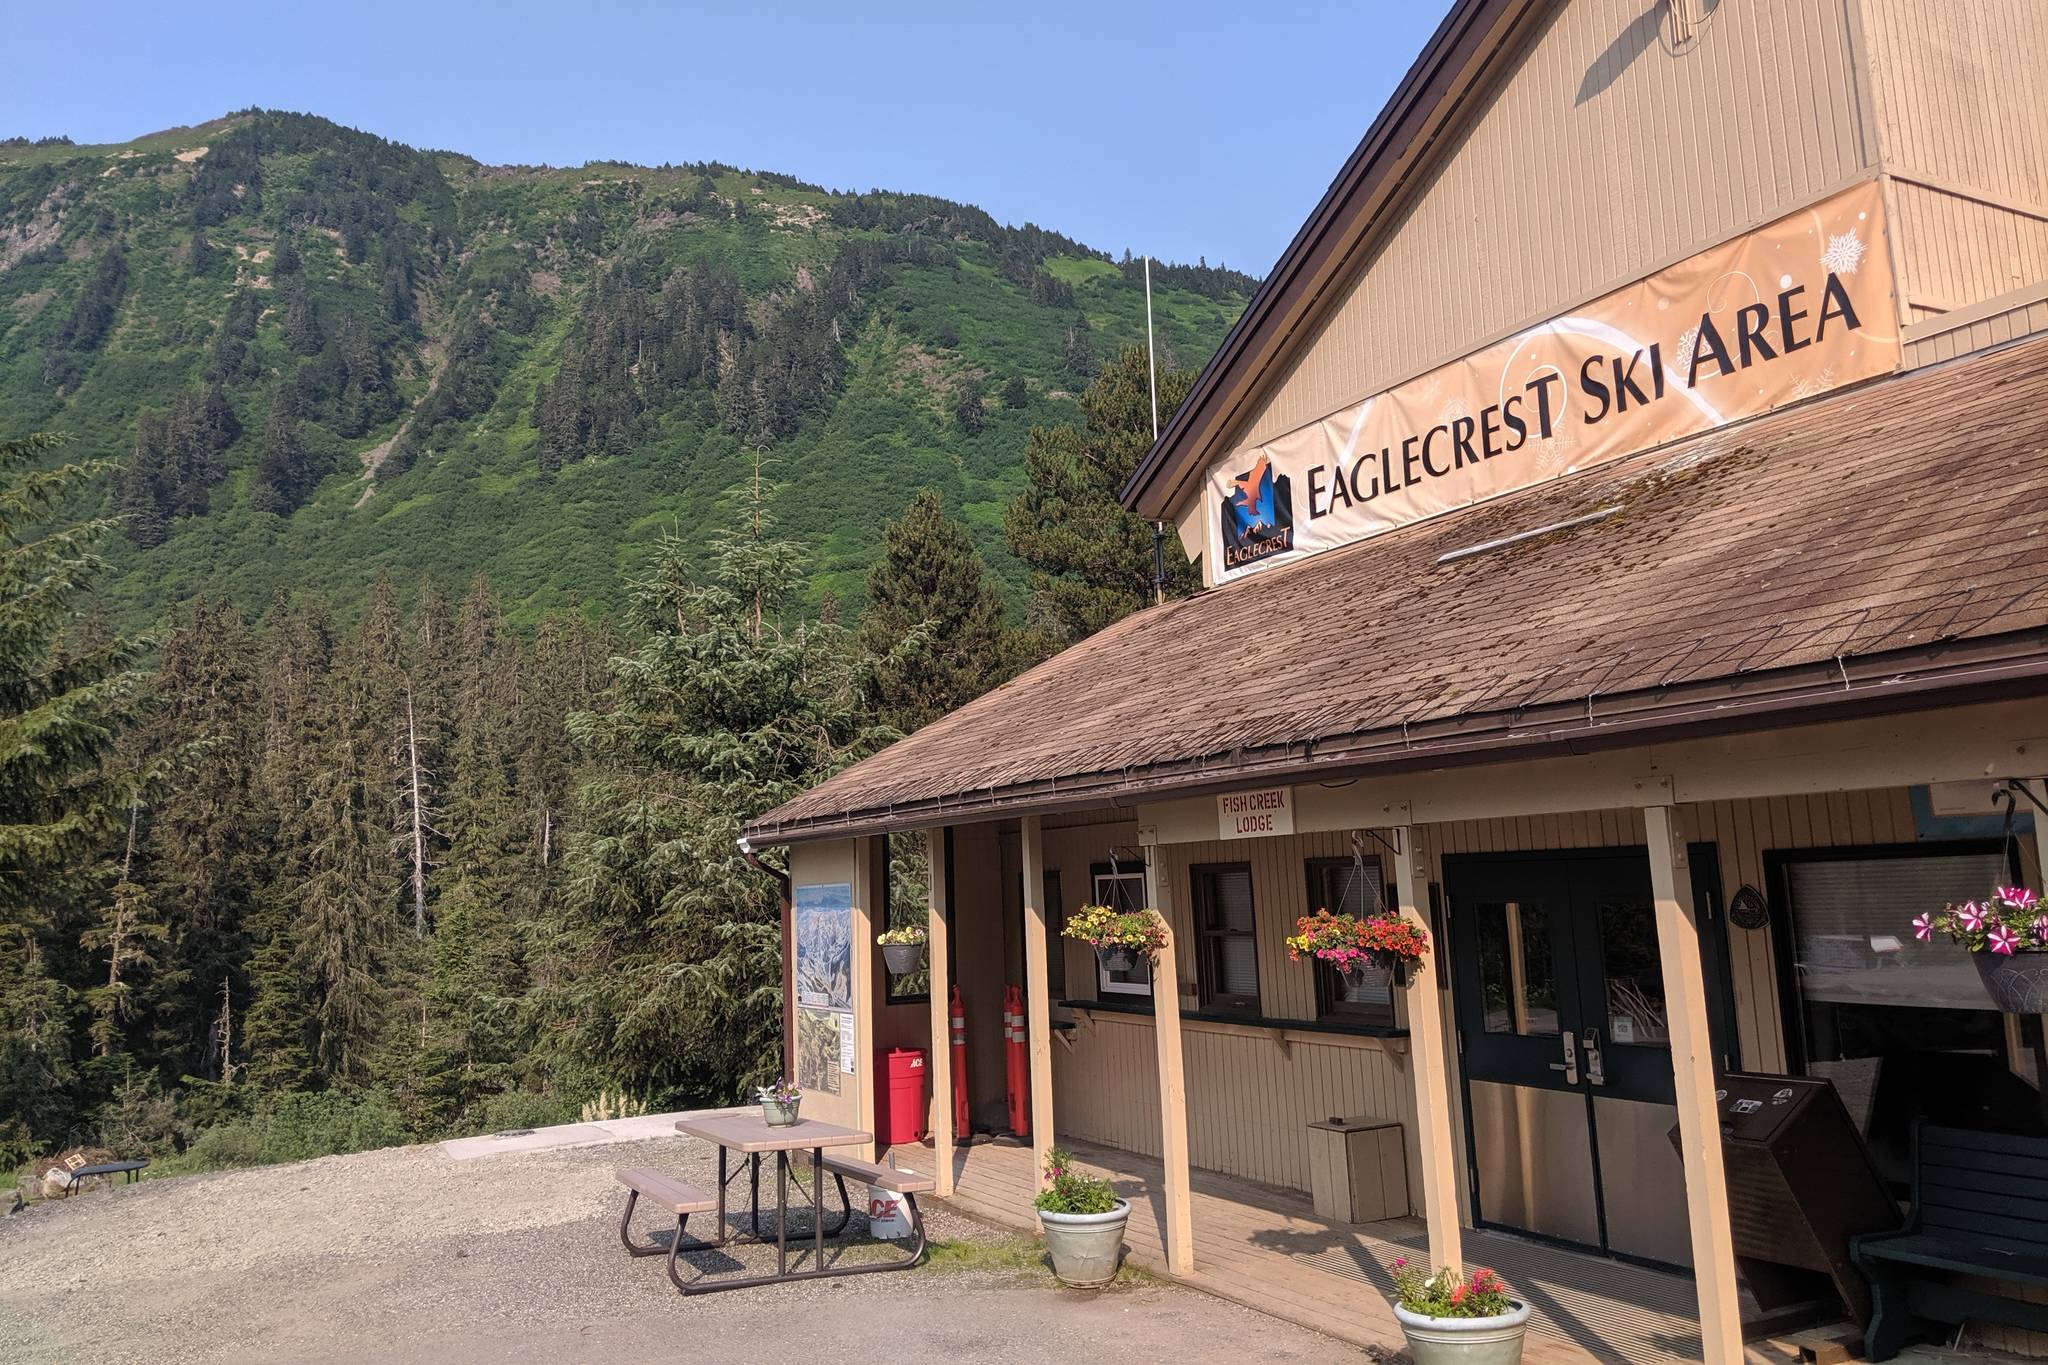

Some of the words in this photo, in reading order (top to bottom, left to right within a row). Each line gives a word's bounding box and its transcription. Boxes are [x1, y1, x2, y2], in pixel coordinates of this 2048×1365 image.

[1307, 372, 1559, 521] EAGLECREST
[1580, 342, 1665, 425] SKI
[1687, 272, 1862, 389] AREA
[1226, 526, 1291, 566] EAGLECREST
[1222, 794, 1248, 814] FISH
[1249, 790, 1285, 811] CREEK
[1236, 814, 1273, 834] LODGE
[910, 1058, 923, 1068] ACE
[869, 1199, 898, 1218] CE
